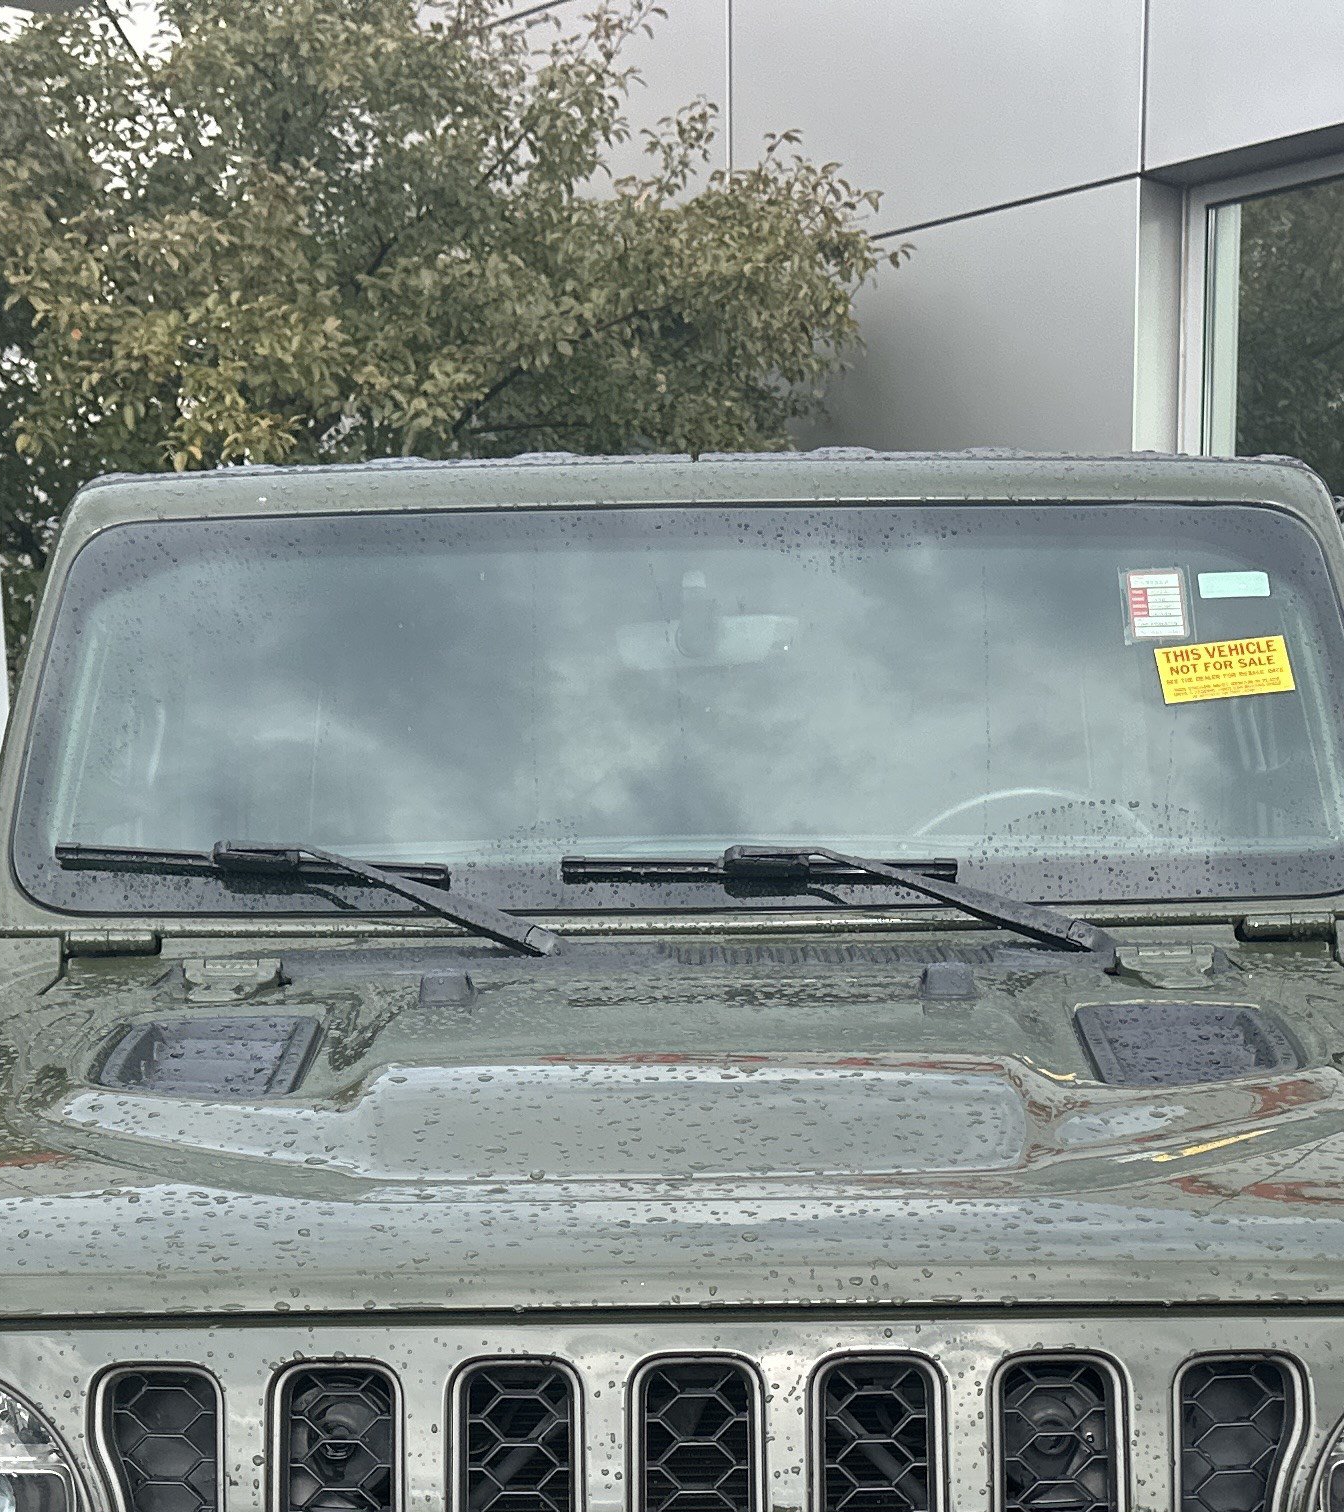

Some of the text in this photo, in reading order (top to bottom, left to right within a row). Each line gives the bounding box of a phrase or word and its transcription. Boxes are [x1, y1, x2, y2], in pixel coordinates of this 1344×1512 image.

[1162, 640, 1277, 664] THIS VEHICLE
[1169, 655, 1275, 676] NOT FOR SALE
